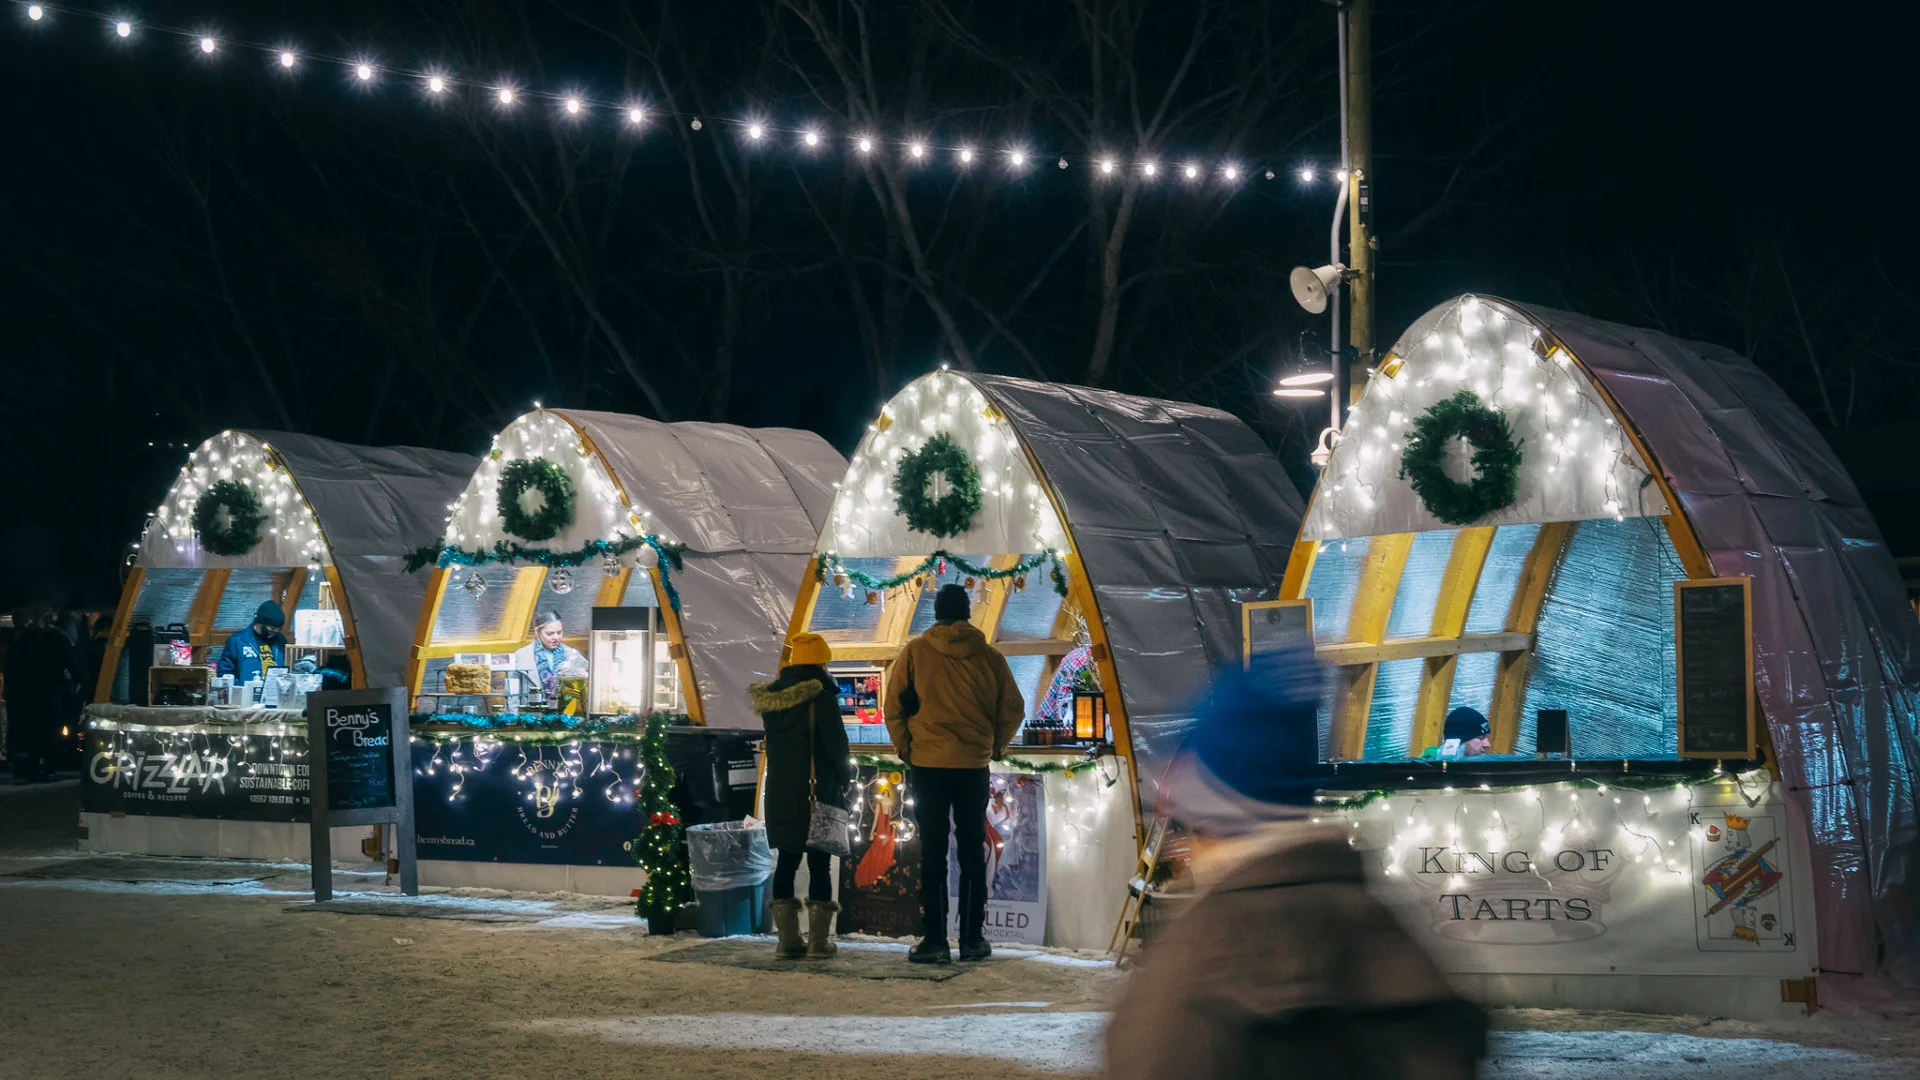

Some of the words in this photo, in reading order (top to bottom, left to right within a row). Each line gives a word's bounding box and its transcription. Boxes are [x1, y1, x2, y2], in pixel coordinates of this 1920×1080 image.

[327, 708, 380, 740] Benny's
[353, 729, 390, 747] Bread
[251, 762, 295, 778] DOWNTOWN
[239, 776, 292, 791] SUSTAINABLE
[123, 791, 146, 800] COFFEE
[147, 790, 155, 800] &
[157, 794, 187, 802] RECORDS
[517, 806, 537, 834] BREAD
[539, 831, 556, 840] AND
[557, 807, 579, 837] BUTTER
[1690, 812, 1701, 825] K
[1417, 847, 1533, 875] KING
[1554, 849, 1615, 873] OF
[1439, 894, 1592, 922] TARTS
